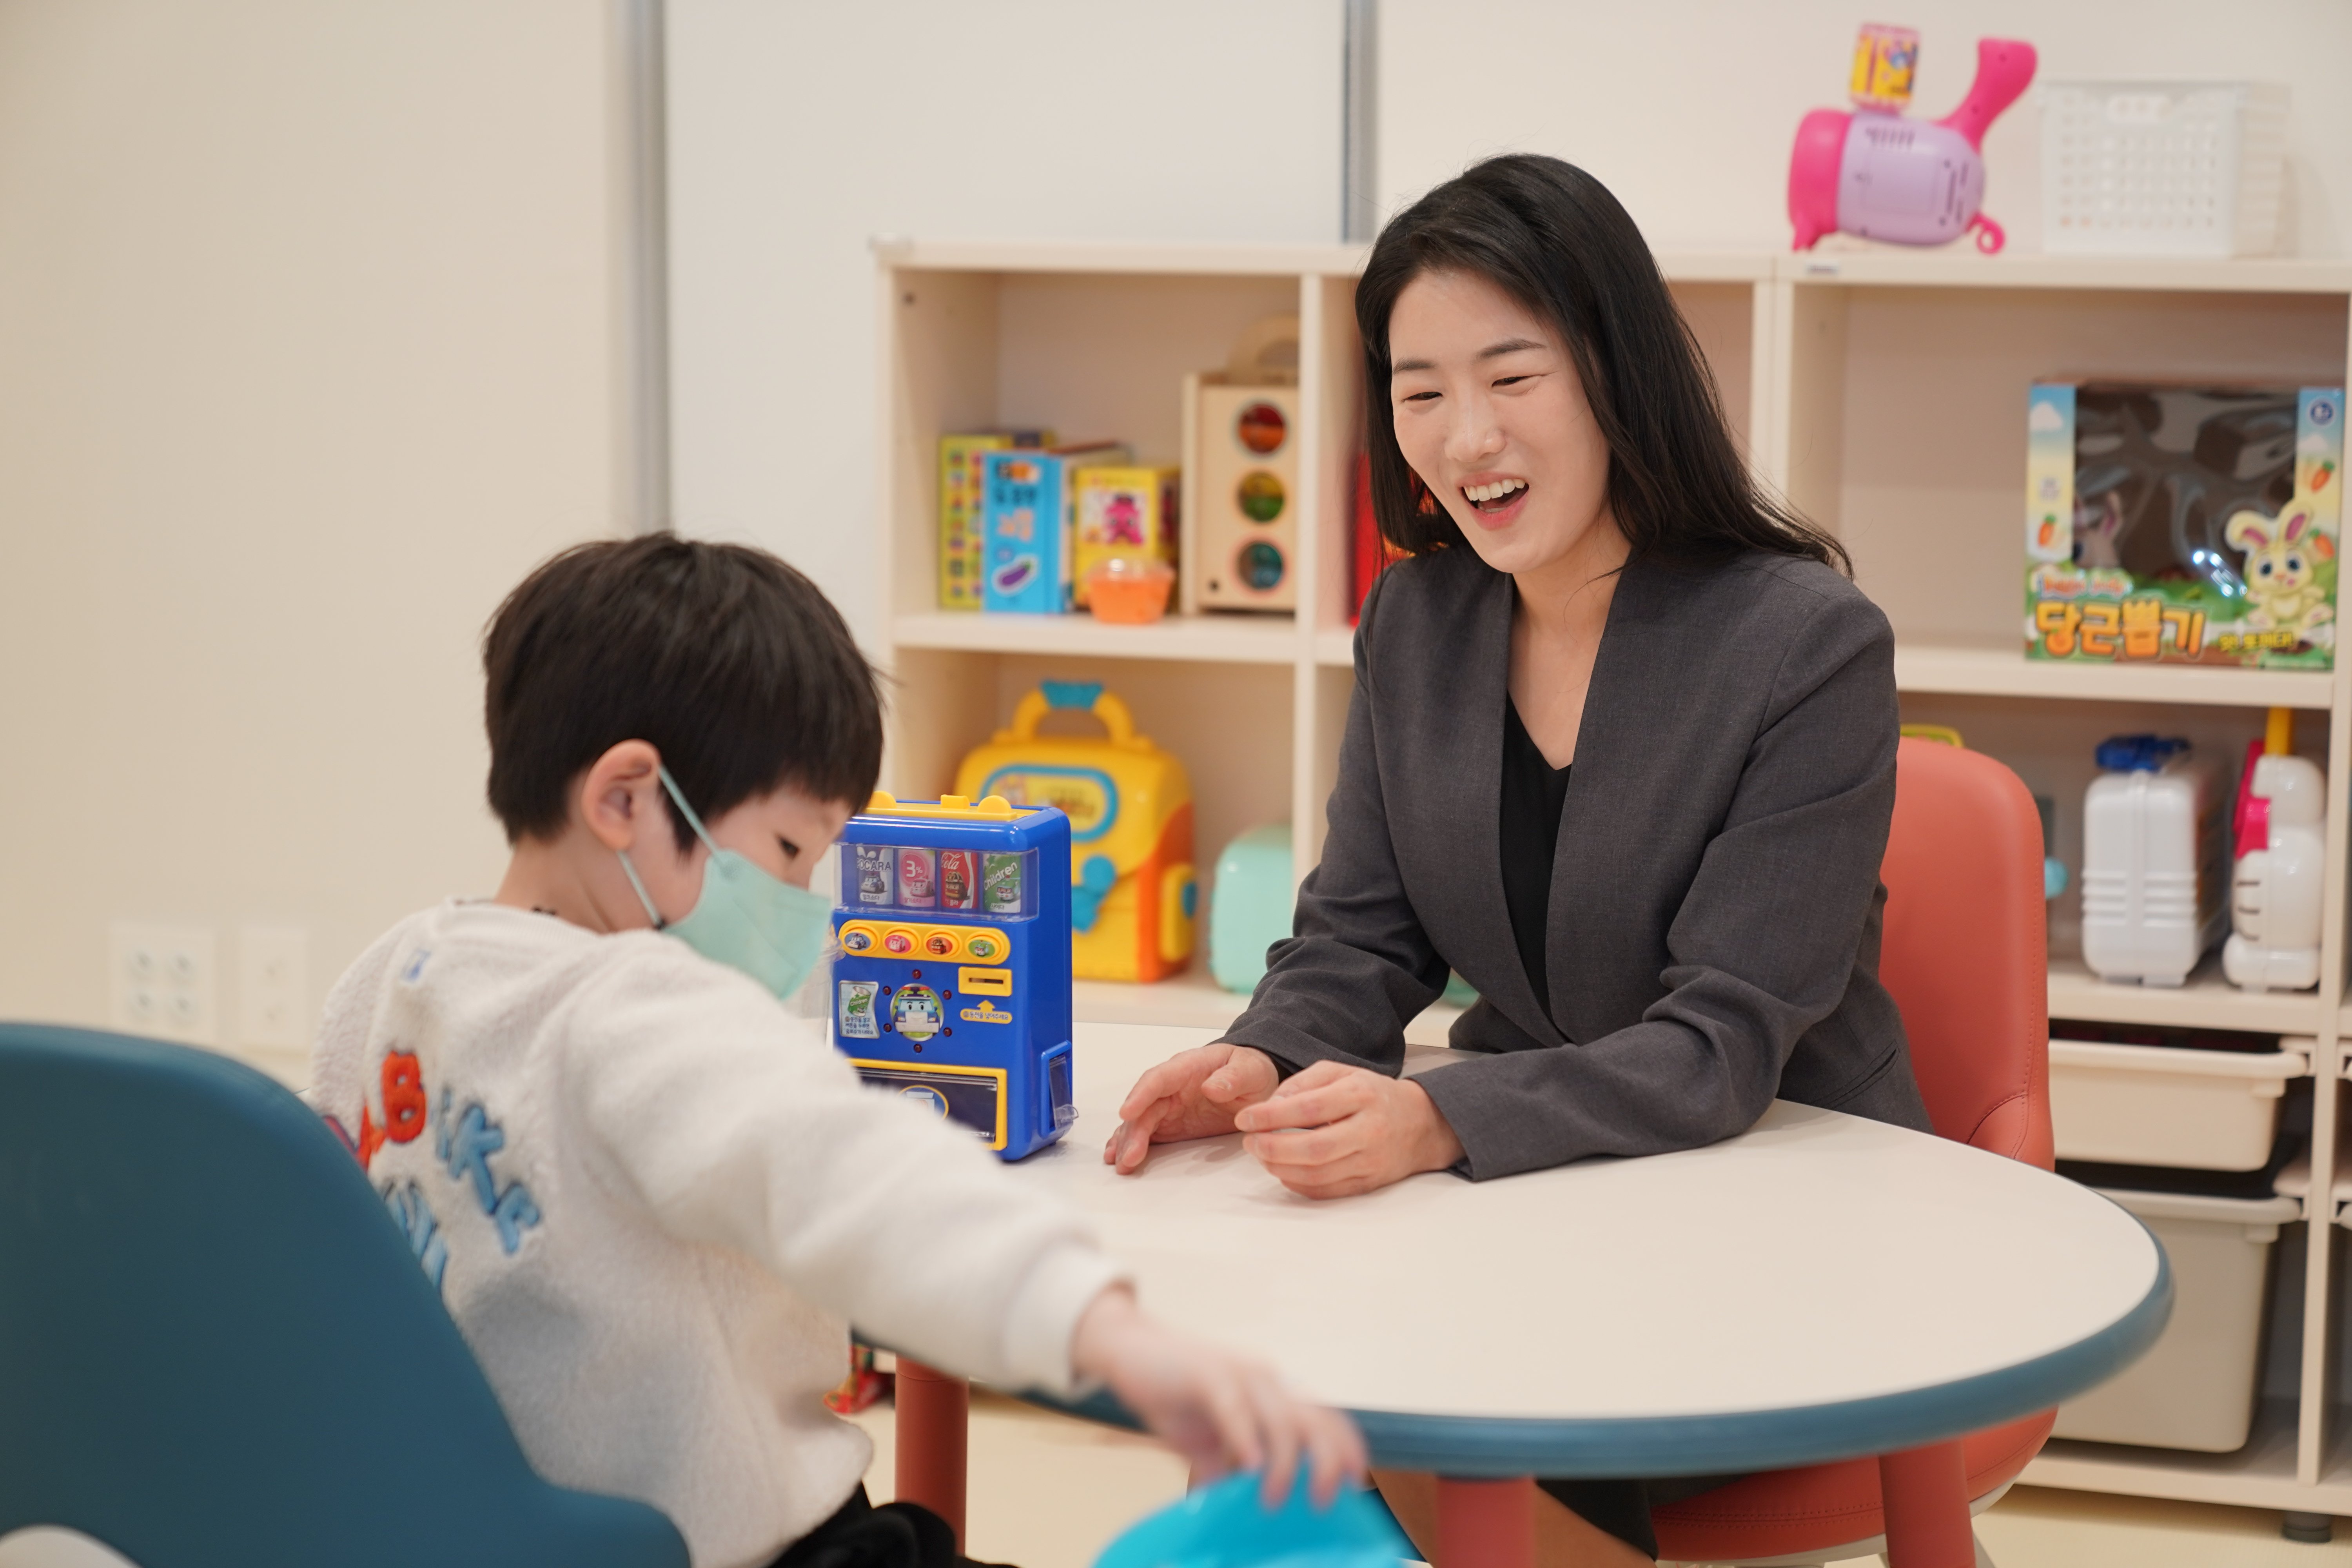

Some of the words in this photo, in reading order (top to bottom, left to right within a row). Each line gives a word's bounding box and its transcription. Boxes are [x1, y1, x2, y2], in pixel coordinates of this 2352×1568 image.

[2036, 598, 2206, 657] 당근뽑기
[906, 860, 923, 878] 3%
[984, 862, 1018, 891] Children
